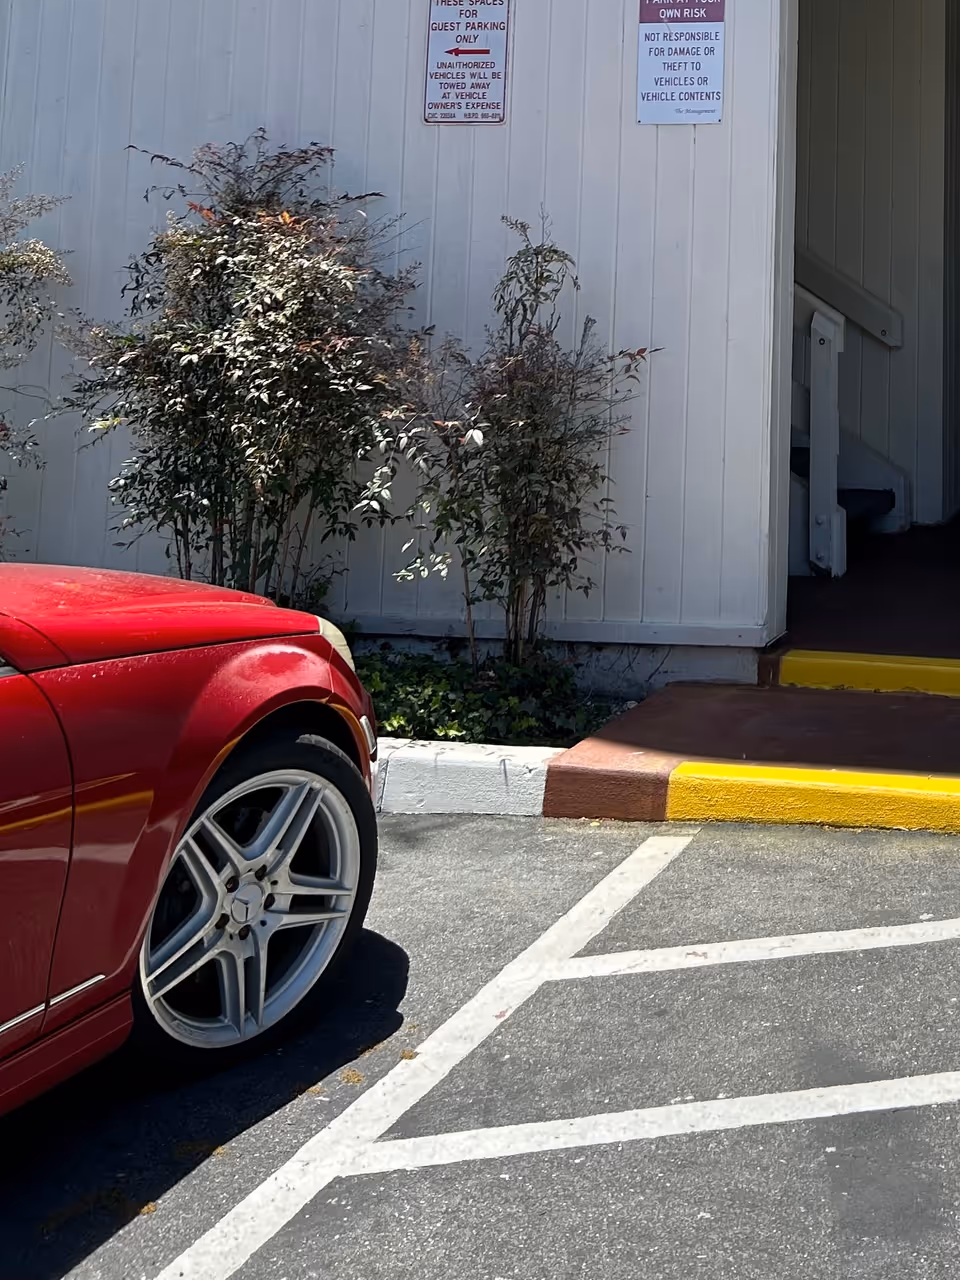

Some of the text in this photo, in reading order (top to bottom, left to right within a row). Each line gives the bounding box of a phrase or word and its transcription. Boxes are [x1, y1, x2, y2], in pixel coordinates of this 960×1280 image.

[459, 10, 478, 18] FOR
[659, 8, 707, 18] OWN RISK
[431, 22, 505, 31] GUEST PARKING
[456, 35, 479, 43] ONLY
[644, 32, 720, 41] NOT RESPONSIBLE
[648, 47, 715, 56] FOR DAMAGE OR
[437, 61, 495, 69] UNAUTHORIZED
[662, 62, 701, 71] THEFT TO
[654, 77, 708, 86] VEHICLES OR
[641, 91, 721, 101] VEHICLE CONTENTS
